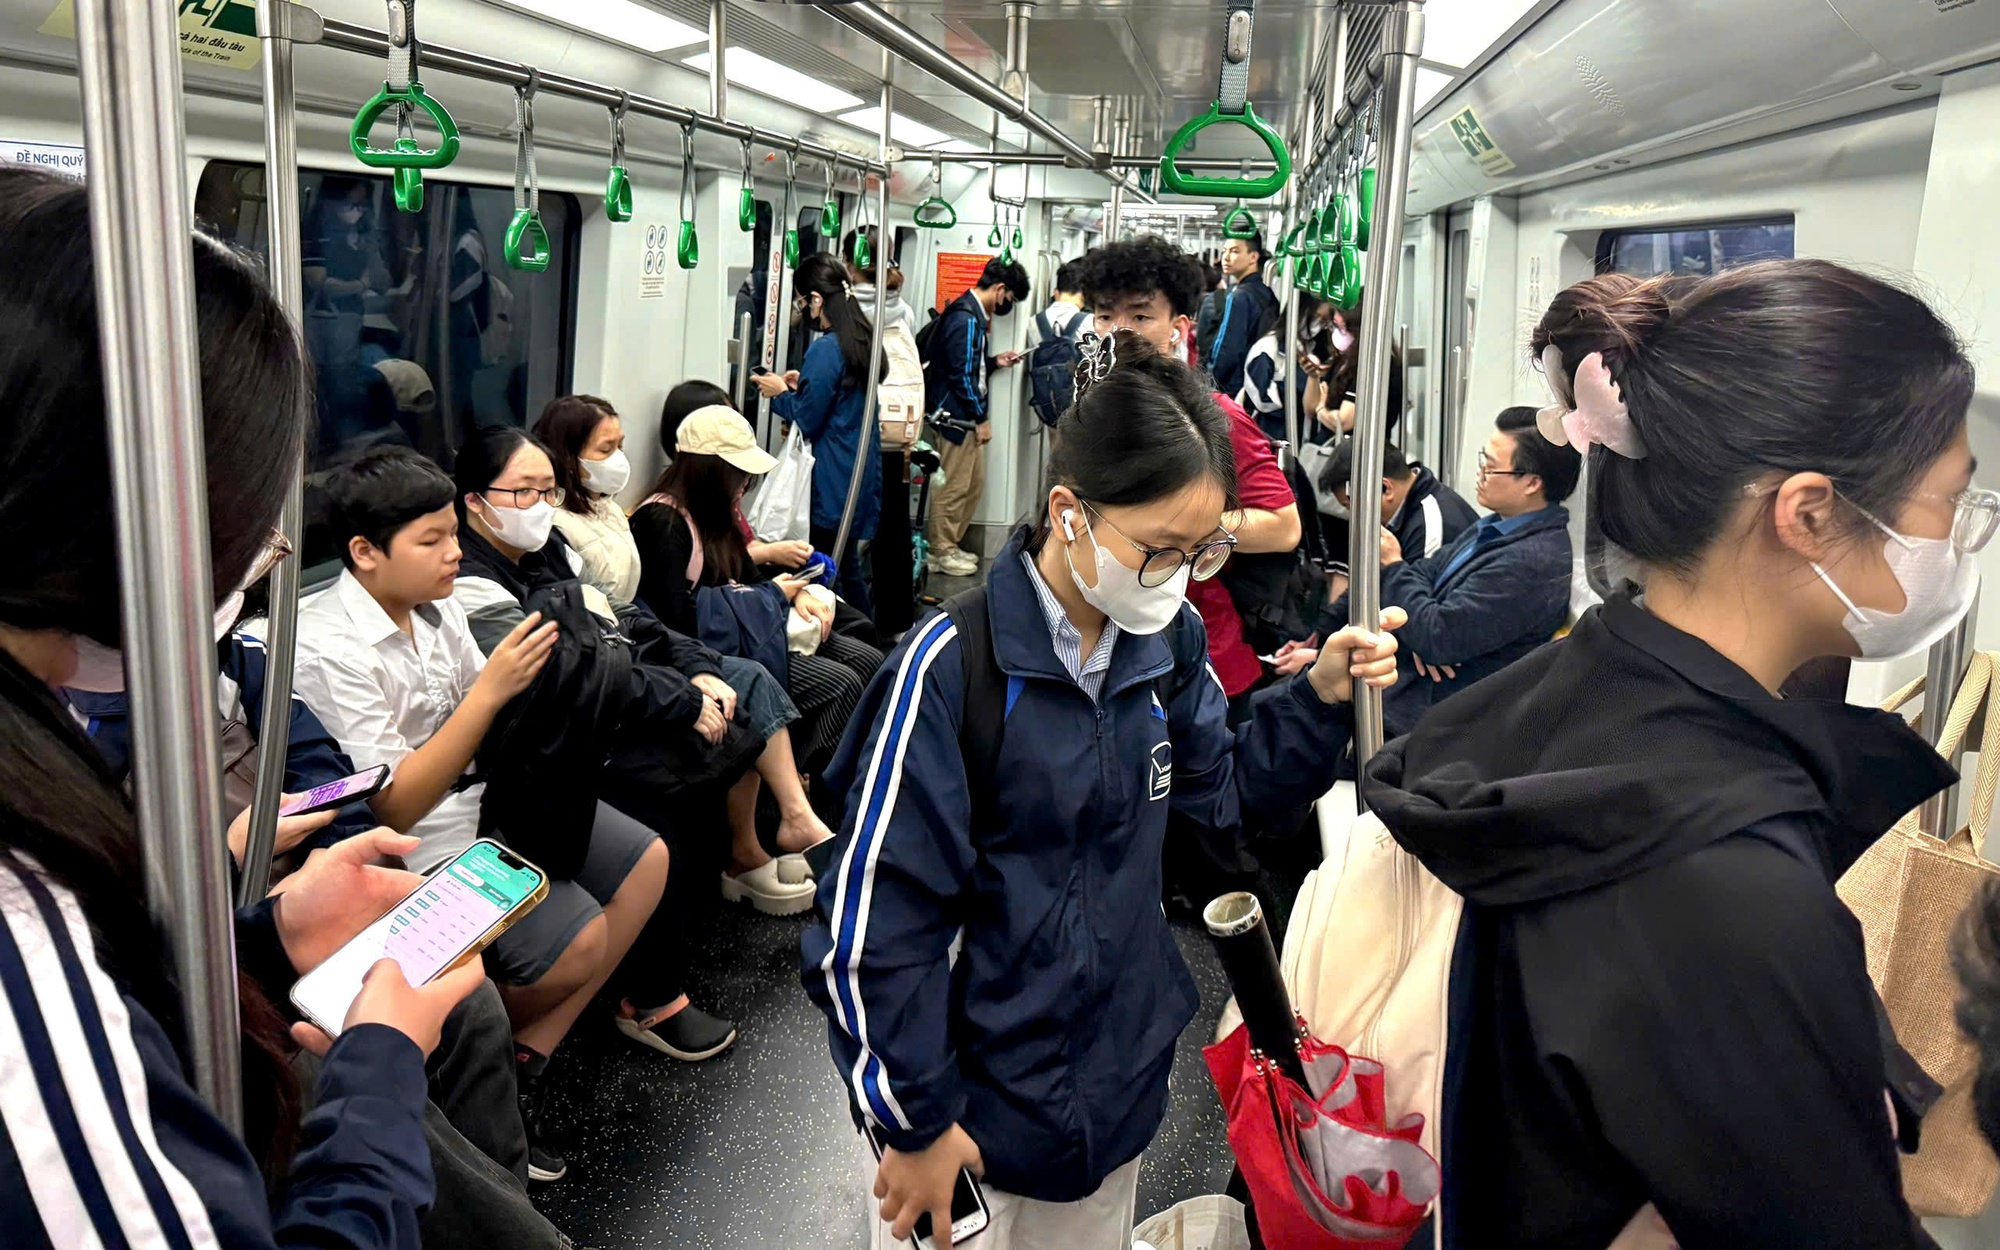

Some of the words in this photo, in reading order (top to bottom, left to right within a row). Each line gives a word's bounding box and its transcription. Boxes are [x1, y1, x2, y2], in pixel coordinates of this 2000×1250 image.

[190, 34, 209, 44] hai
[208, 37, 228, 48] đầu
[228, 42, 246, 52] tàu
[214, 52, 231, 61] Train
[16, 149, 31, 162] ĐỀ
[33, 153, 60, 167] NGHỊ
[62, 154, 84, 167] QUÝ
